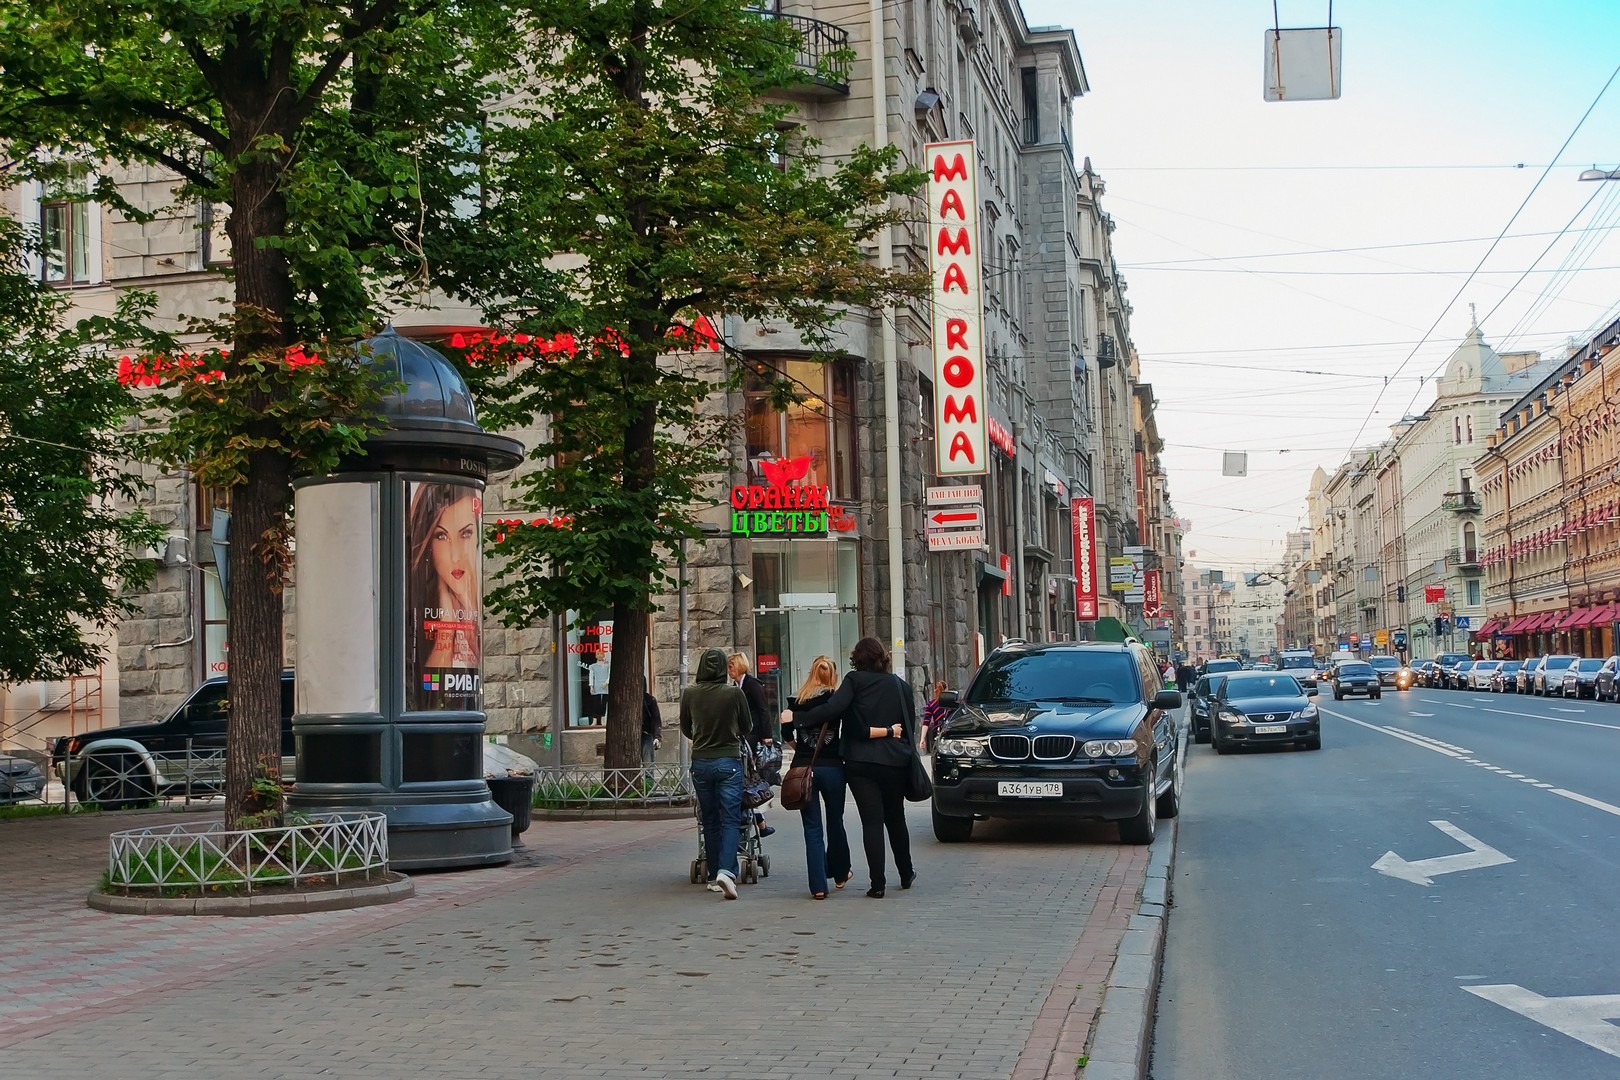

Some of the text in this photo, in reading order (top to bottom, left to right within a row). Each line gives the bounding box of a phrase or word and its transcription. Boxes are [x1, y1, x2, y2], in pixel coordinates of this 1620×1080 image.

[934, 153, 977, 465] MAMA ROMA
[731, 484, 829, 510] ОРАНЖ
[731, 511, 828, 538] ЦВЕТЫ
[424, 607, 450, 620] PURA
[1083, 602, 1091, 611] 2
[586, 625, 613, 636] НОВ
[444, 673, 473, 691] РИВ
[1044, 784, 1060, 792] 178
